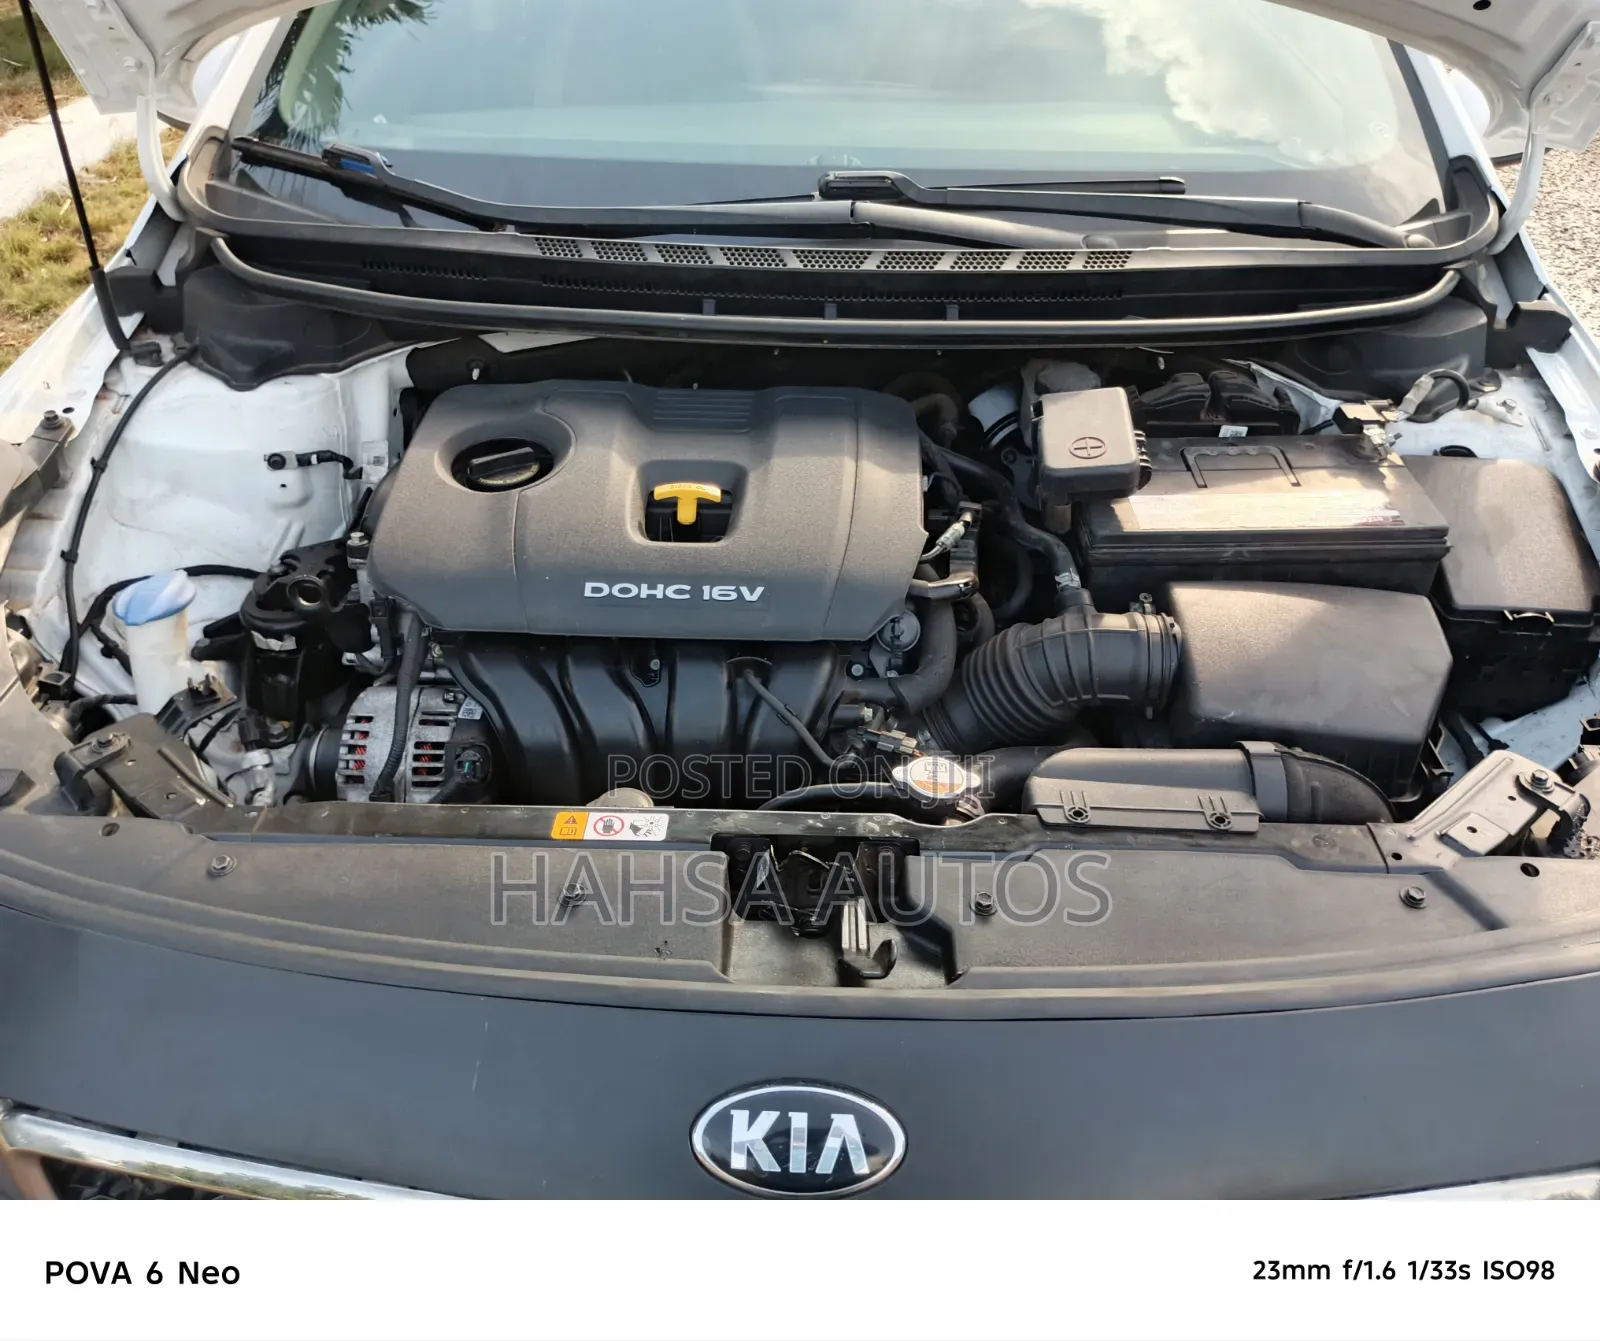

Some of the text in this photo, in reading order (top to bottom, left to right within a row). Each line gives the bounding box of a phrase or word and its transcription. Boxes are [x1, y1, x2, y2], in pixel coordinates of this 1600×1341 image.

[584, 582, 765, 602] DOHC 16V
[729, 1109, 871, 1174] KIA
